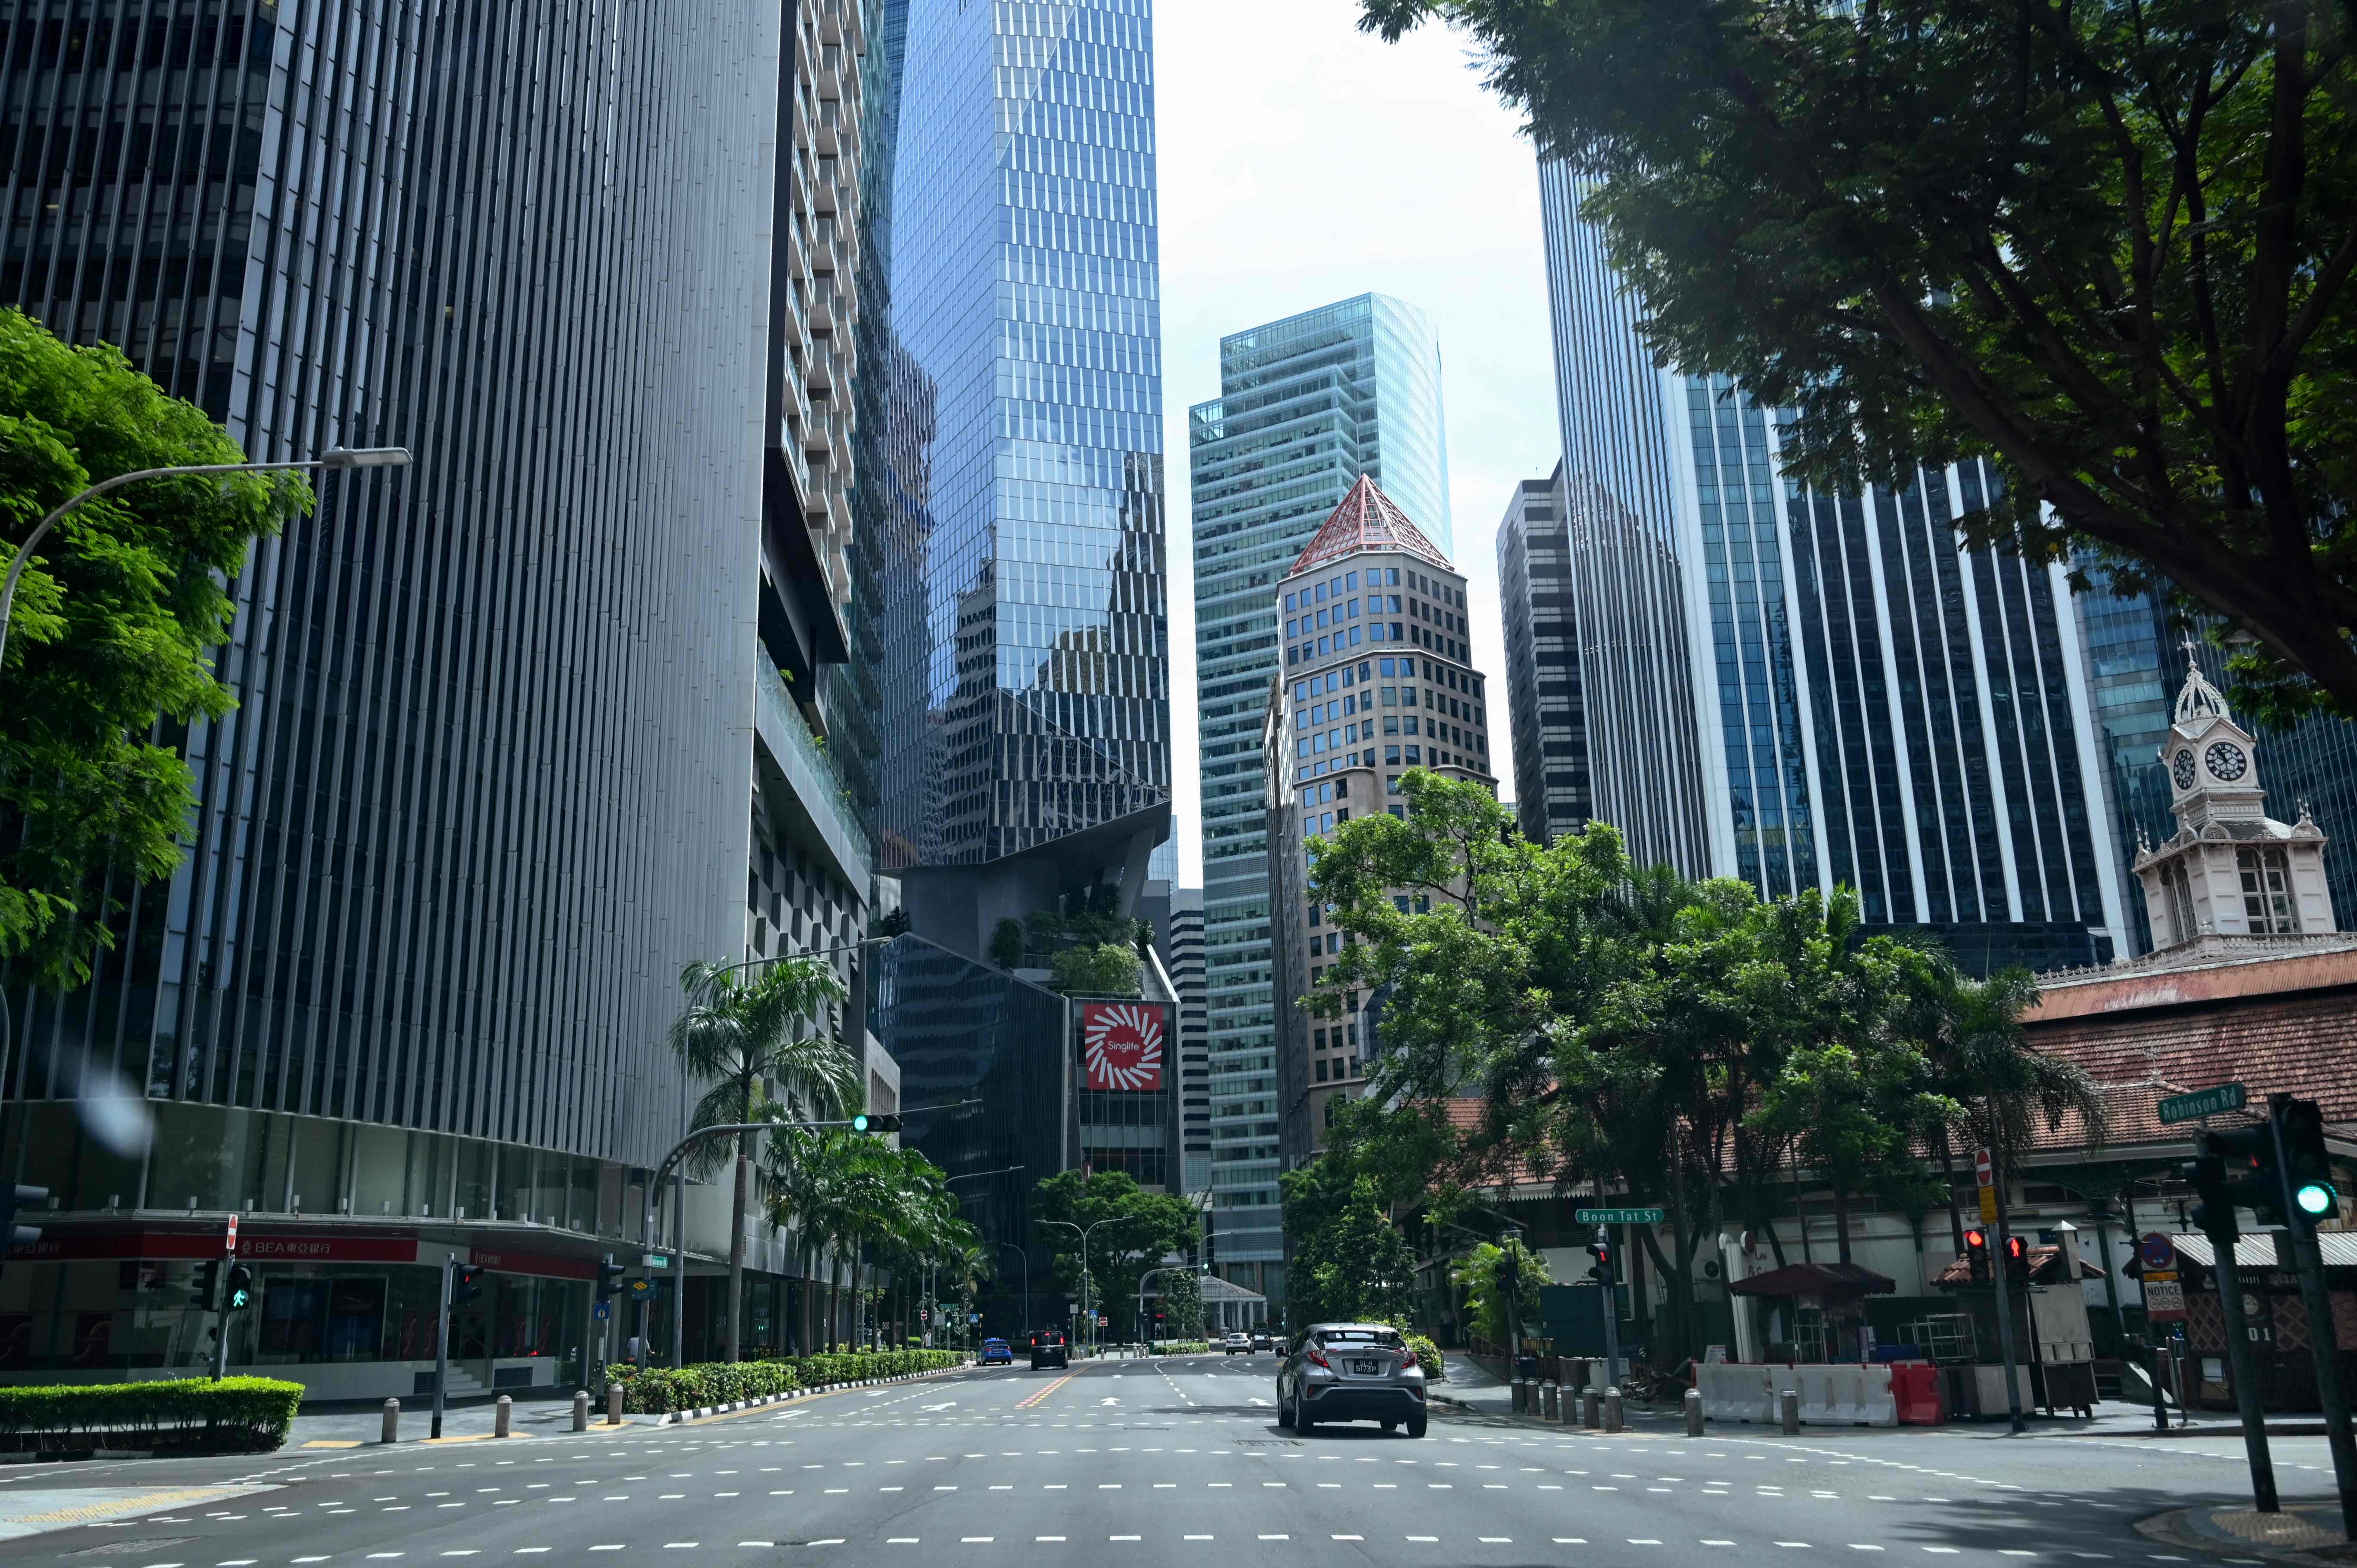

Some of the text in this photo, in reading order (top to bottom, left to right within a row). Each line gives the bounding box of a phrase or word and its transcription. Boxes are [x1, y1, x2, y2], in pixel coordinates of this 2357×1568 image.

[1108, 1041, 1139, 1053] Singlife
[2162, 1087, 2236, 1120] Robinson Rd
[1582, 1210, 1657, 1222] Boon Tat St
[255, 1242, 284, 1253] BEA
[2147, 1286, 2180, 1296] NOTICE
